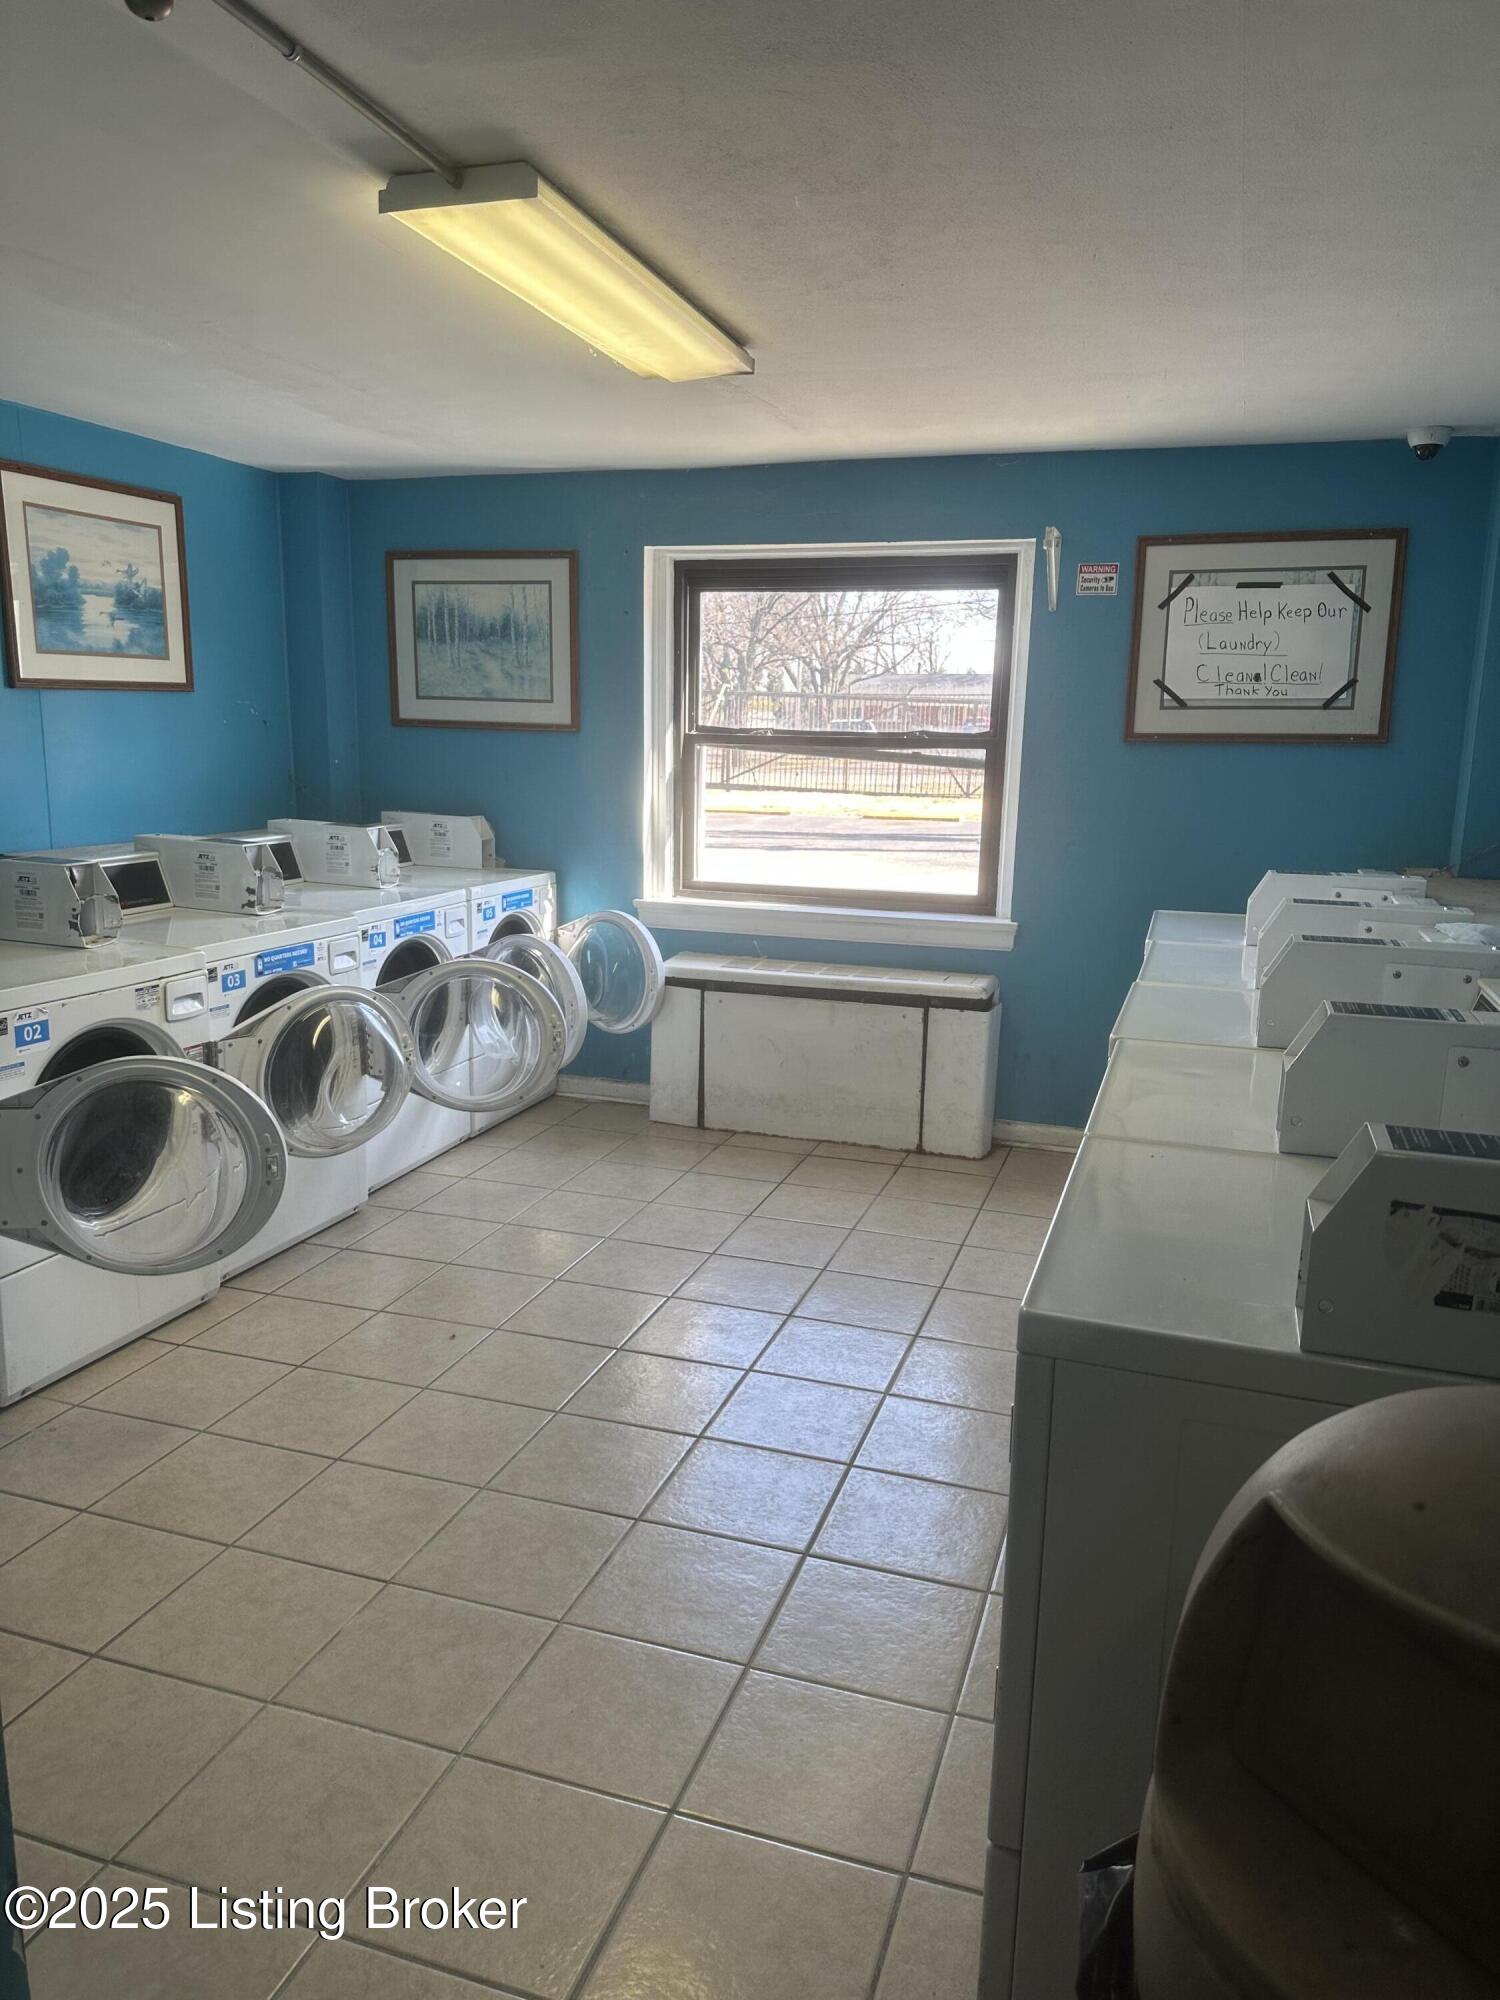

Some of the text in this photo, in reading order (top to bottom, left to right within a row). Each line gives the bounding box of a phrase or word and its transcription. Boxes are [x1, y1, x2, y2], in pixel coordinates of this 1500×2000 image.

[1081, 565, 1117, 573] WARNING
[1080, 576, 1100, 584] Security
[1080, 584, 1099, 592] Cameras
[1183, 596, 1348, 626] Please Help Keep Our
[1264, 685, 1289, 697] You
[373, 934, 383, 945] 04
[227, 973, 241, 988] 03
[16, 1011, 33, 1020] JETZ
[23, 1024, 42, 1042] 02
